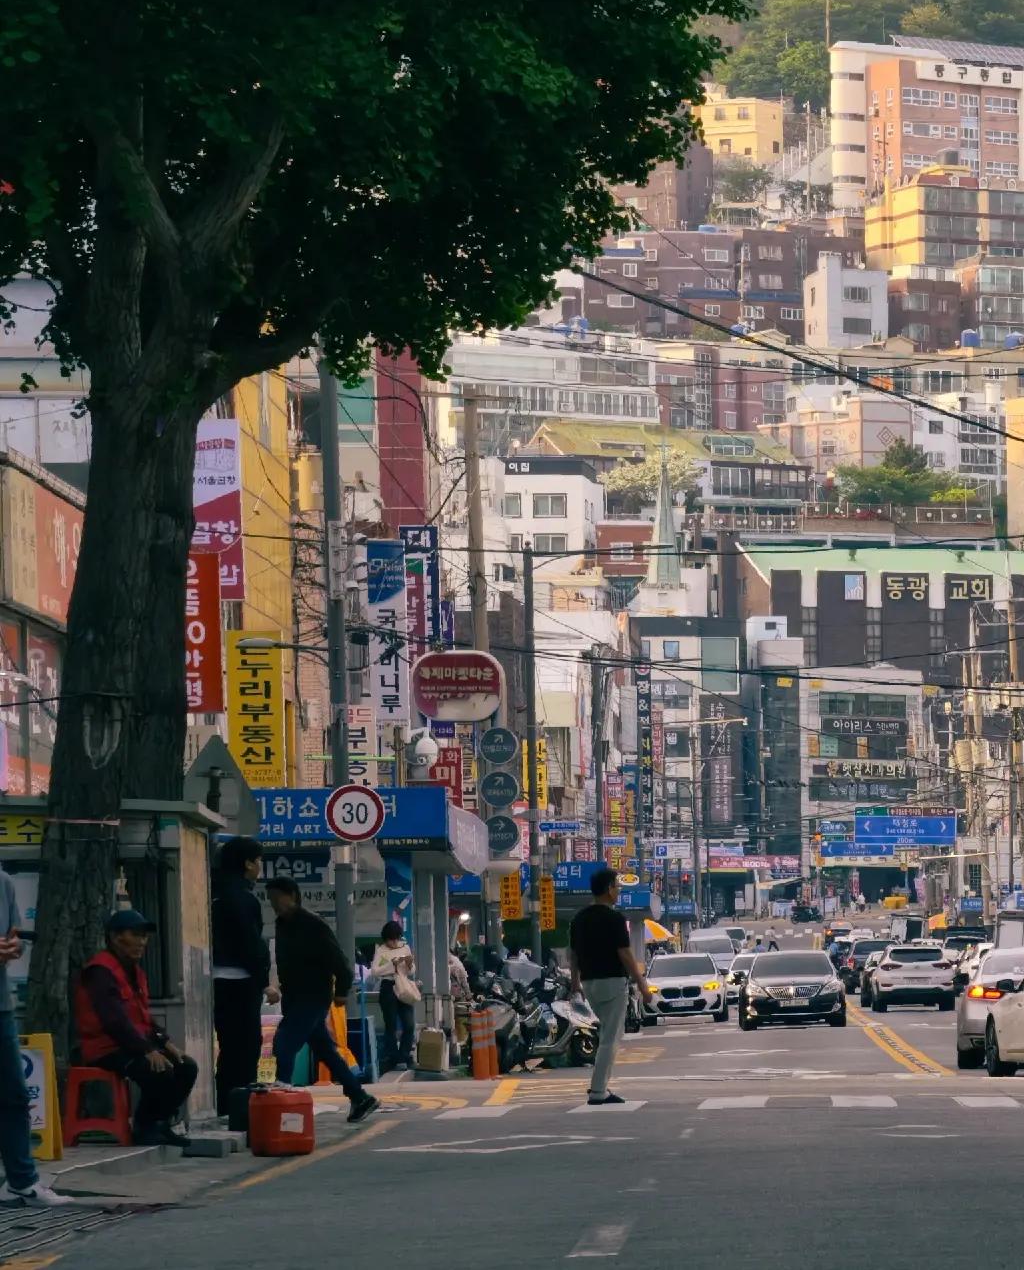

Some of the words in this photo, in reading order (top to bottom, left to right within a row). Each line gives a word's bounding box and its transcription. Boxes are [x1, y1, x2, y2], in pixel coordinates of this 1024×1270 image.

[934, 63, 1012, 84] 중구종합
[885, 576, 928, 600] 동광
[950, 578, 990, 600] 교회
[342, 802, 369, 824] 30
[293, 824, 321, 835] ART
